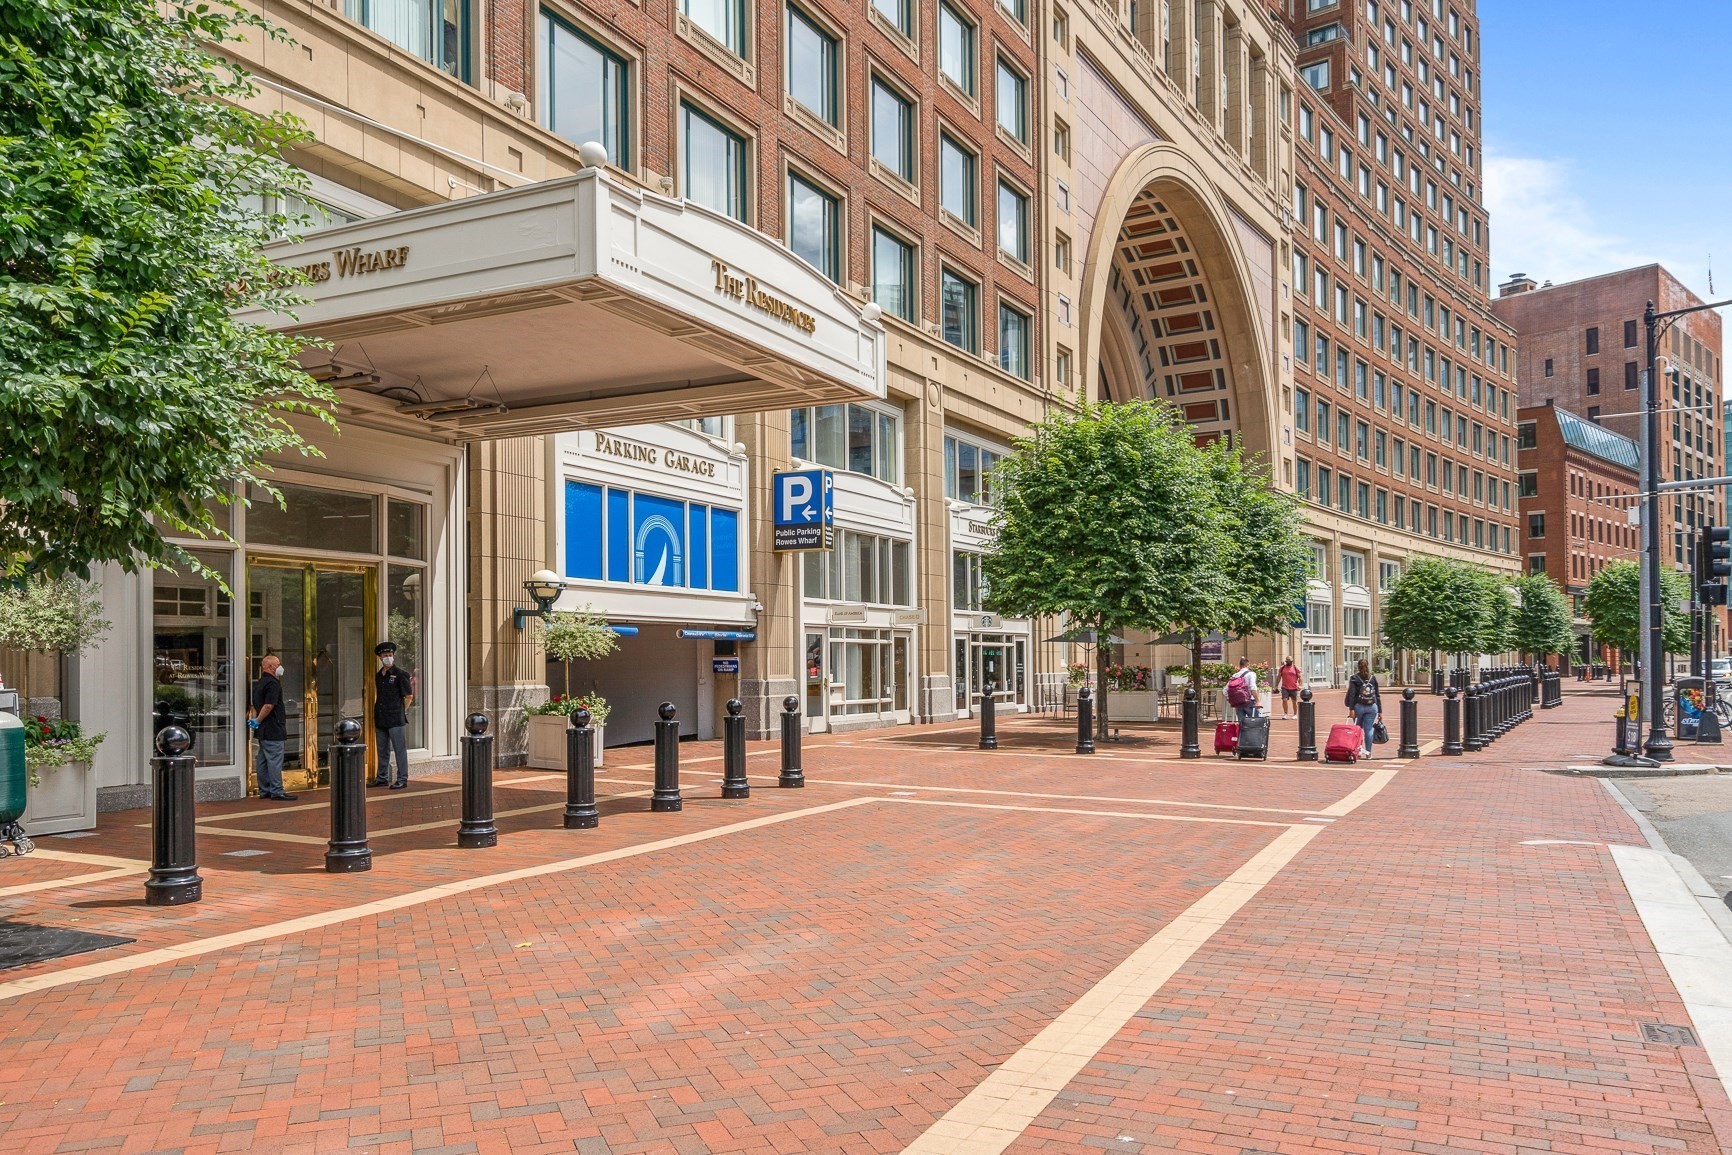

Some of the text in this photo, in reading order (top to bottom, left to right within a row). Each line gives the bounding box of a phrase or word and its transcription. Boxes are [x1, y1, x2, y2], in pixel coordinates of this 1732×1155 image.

[332, 246, 410, 277] WHARF
[712, 260, 815, 333] THE RESIDENCES
[595, 432, 715, 478] PARKING GARAGE
[825, 476, 833, 493] P
[783, 476, 813, 521] P
[775, 529, 796, 537] Public
[796, 527, 821, 536] Parking
[968, 520, 996, 537] STARBUCKS
[775, 536, 818, 546] Rowes Wharf
